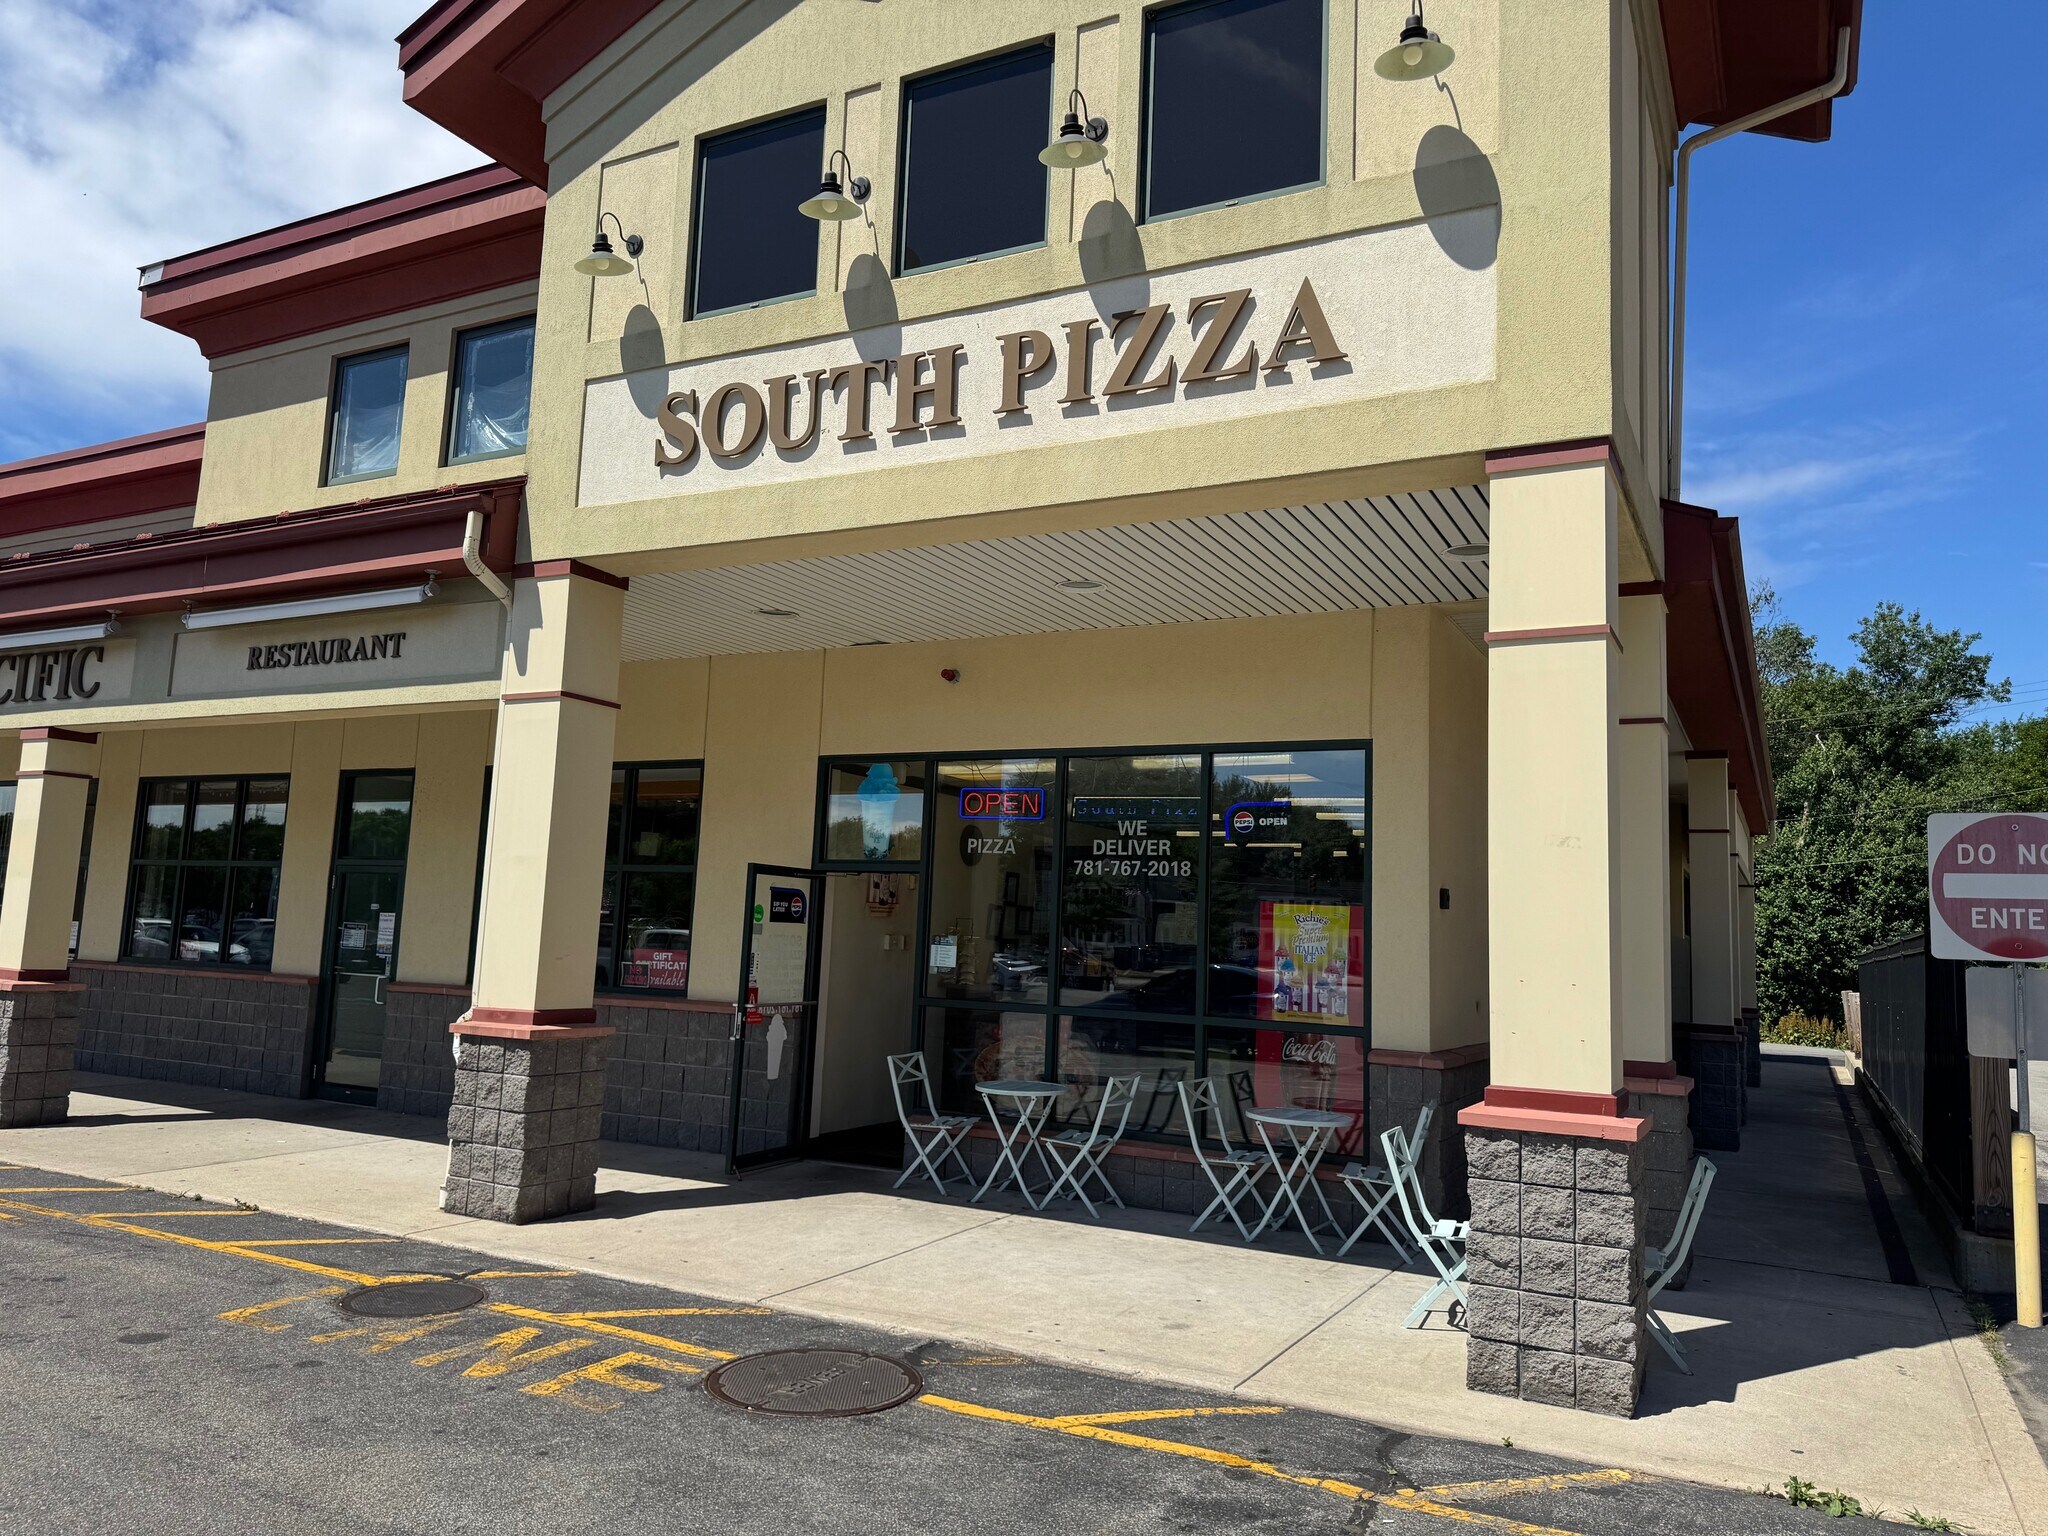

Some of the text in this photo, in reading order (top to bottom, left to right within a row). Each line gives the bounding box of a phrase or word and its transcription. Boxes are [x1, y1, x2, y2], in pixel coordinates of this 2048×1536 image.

[654, 276, 1349, 468] SOUTH PIZZA
[246, 632, 406, 670] RESTAURANT
[963, 792, 1039, 815] OPEN
[1117, 820, 1148, 836] WE
[1259, 817, 1288, 826] OPEN
[967, 838, 1016, 855] PIZZA
[1093, 839, 1171, 856] DELIVER
[1957, 843, 1996, 865] DO
[1073, 860, 1192, 877] 781-767-2018
[1294, 911, 1330, 926] Richie's
[653, 952, 673, 961] GIFT
[1294, 945, 1326, 955] ITALIAN
[1282, 1038, 1336, 1065] Coca-Cola
